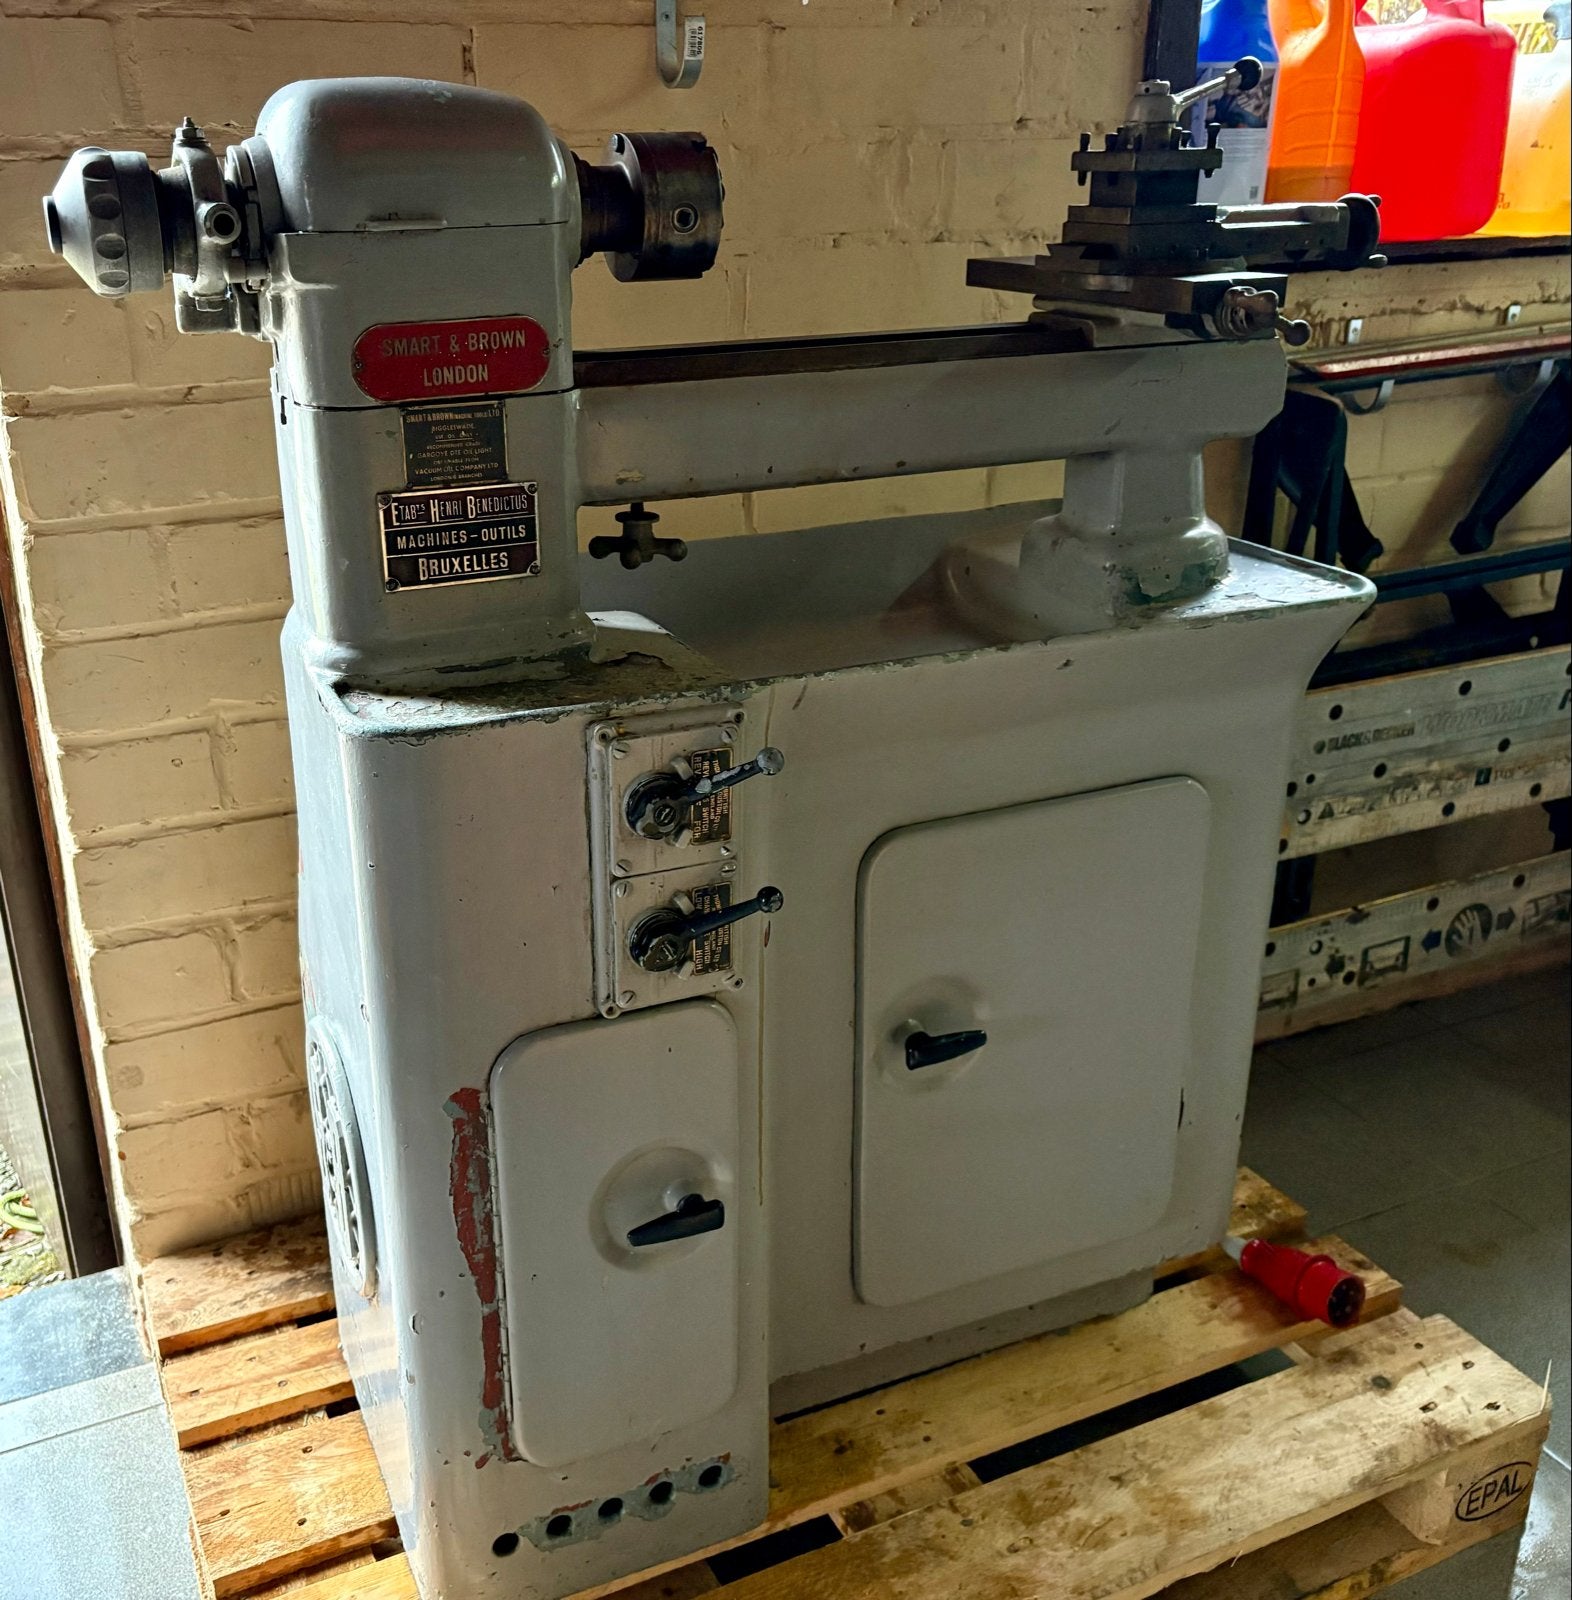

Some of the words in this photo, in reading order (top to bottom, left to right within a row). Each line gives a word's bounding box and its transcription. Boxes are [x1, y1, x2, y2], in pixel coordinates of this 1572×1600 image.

[382, 335, 440, 357] SMART
[450, 334, 460, 352] &
[468, 330, 526, 351] BROWN
[423, 364, 488, 387] LONDON
[414, 466, 442, 475] VACUUM
[455, 463, 487, 471] COMPANY
[430, 499, 463, 523] HENRI
[467, 494, 528, 519] BENEDICTUS
[418, 552, 509, 581] BRUXELLES
[1465, 1470, 1522, 1516] EPAL
